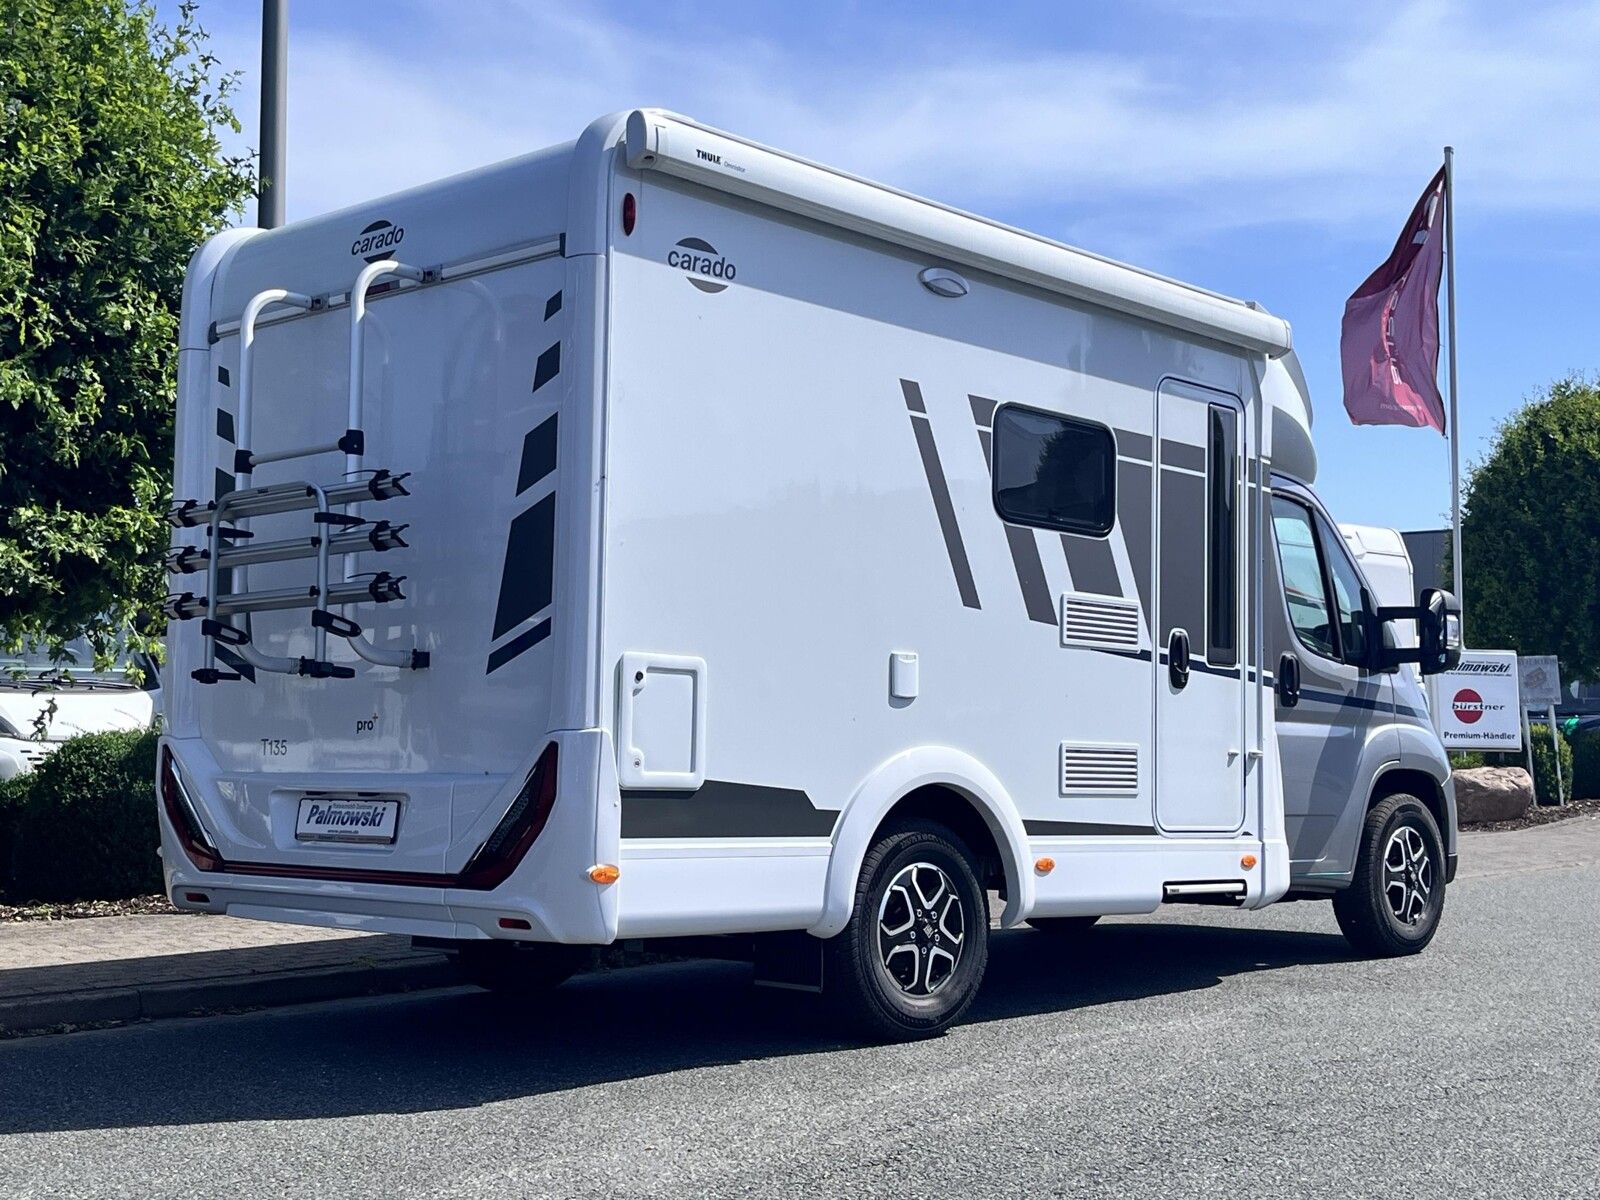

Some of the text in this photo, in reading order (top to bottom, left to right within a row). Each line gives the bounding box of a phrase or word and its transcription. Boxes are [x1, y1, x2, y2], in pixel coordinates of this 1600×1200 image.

[696, 149, 721, 165] THULE
[351, 226, 404, 255] carado
[668, 251, 736, 280] carado
[1452, 702, 1505, 711] bürstner
[1444, 731, 1516, 740] Premium-Händler
[261, 738, 287, 755] T135
[306, 805, 386, 827] Palmowski
